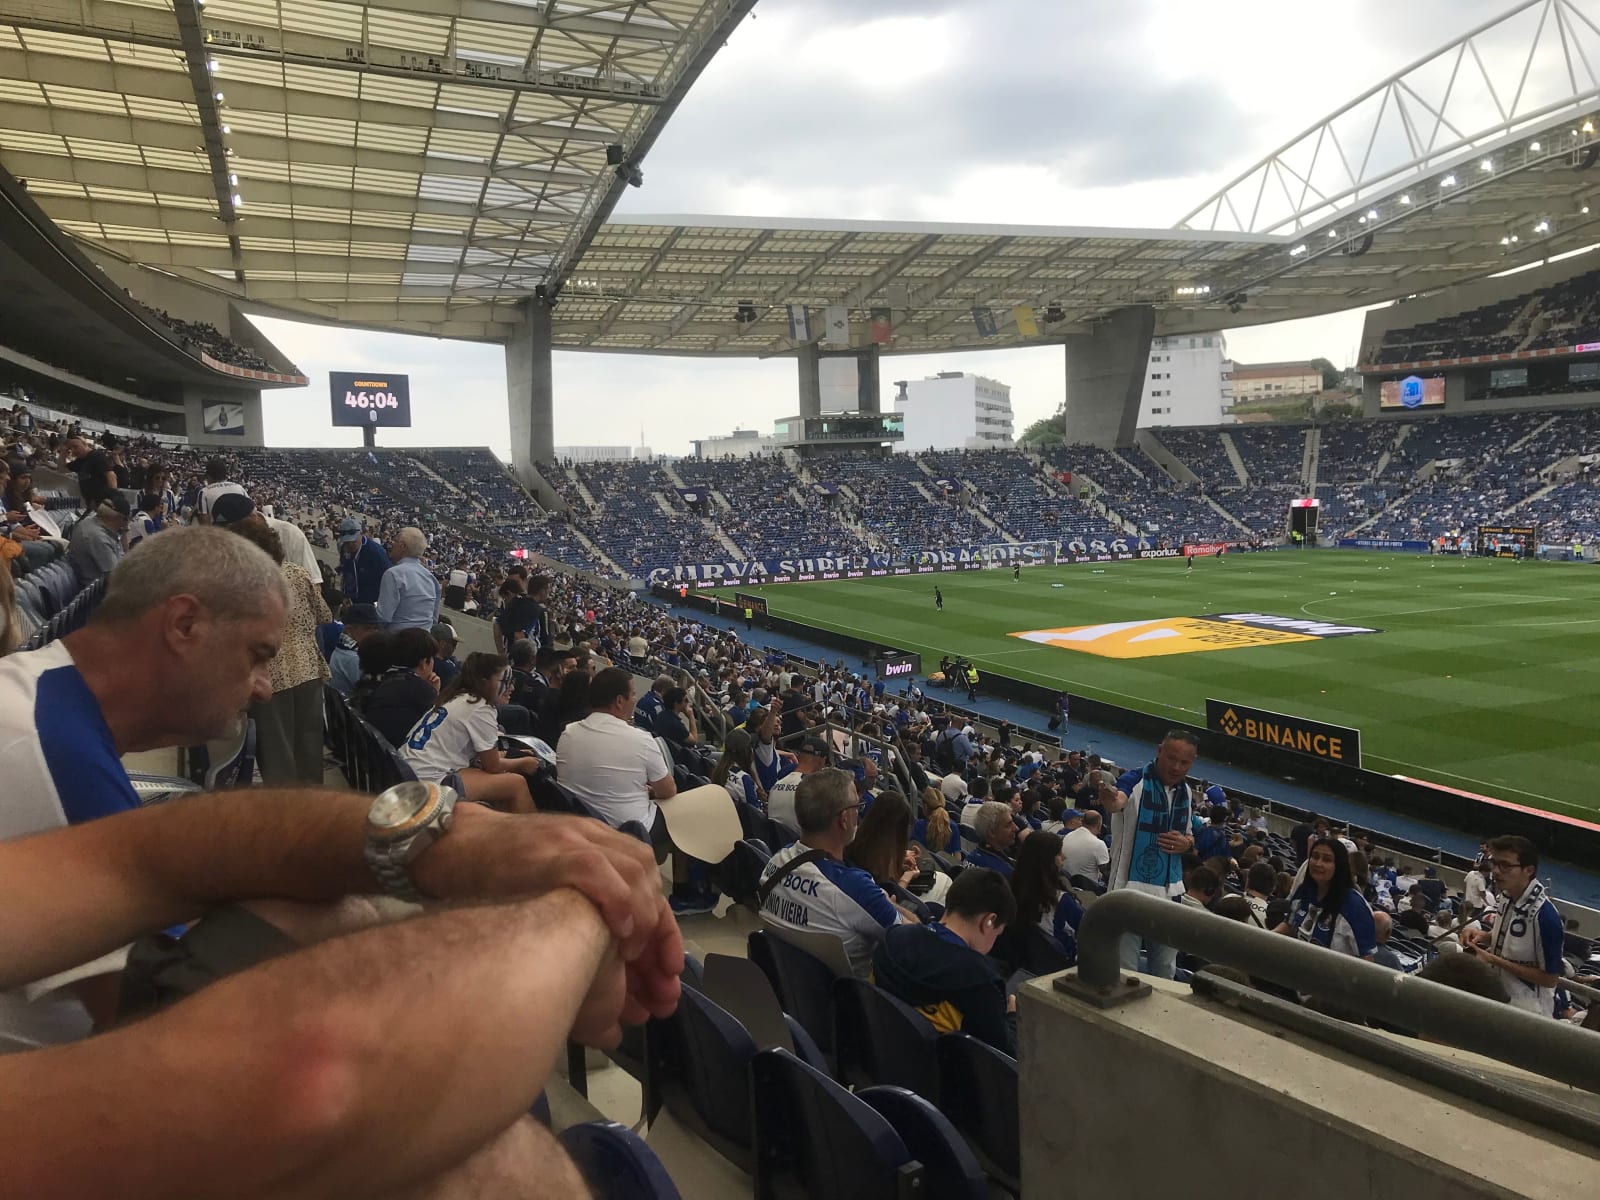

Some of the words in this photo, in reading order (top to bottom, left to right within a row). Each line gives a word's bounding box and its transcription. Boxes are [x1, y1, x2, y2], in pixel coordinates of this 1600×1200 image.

[345, 391, 399, 409] 46:04
[648, 561, 769, 585] CURVA
[697, 580, 715, 588] bwin
[773, 575, 791, 583] bwin
[798, 573, 815, 581] bwin
[823, 571, 840, 579] bwin
[847, 570, 864, 578] bwin
[871, 568, 887, 576] bwin
[894, 567, 911, 575] bwin
[918, 565, 934, 573] bwin
[941, 563, 957, 571] bwin
[1097, 553, 1112, 561] bwin
[885, 660, 912, 676] bwin
[408, 706, 449, 751] 8
[1245, 718, 1343, 759] BINANCE
[784, 872, 820, 898] BOCK
[780, 898, 809, 927] VIEIRA
